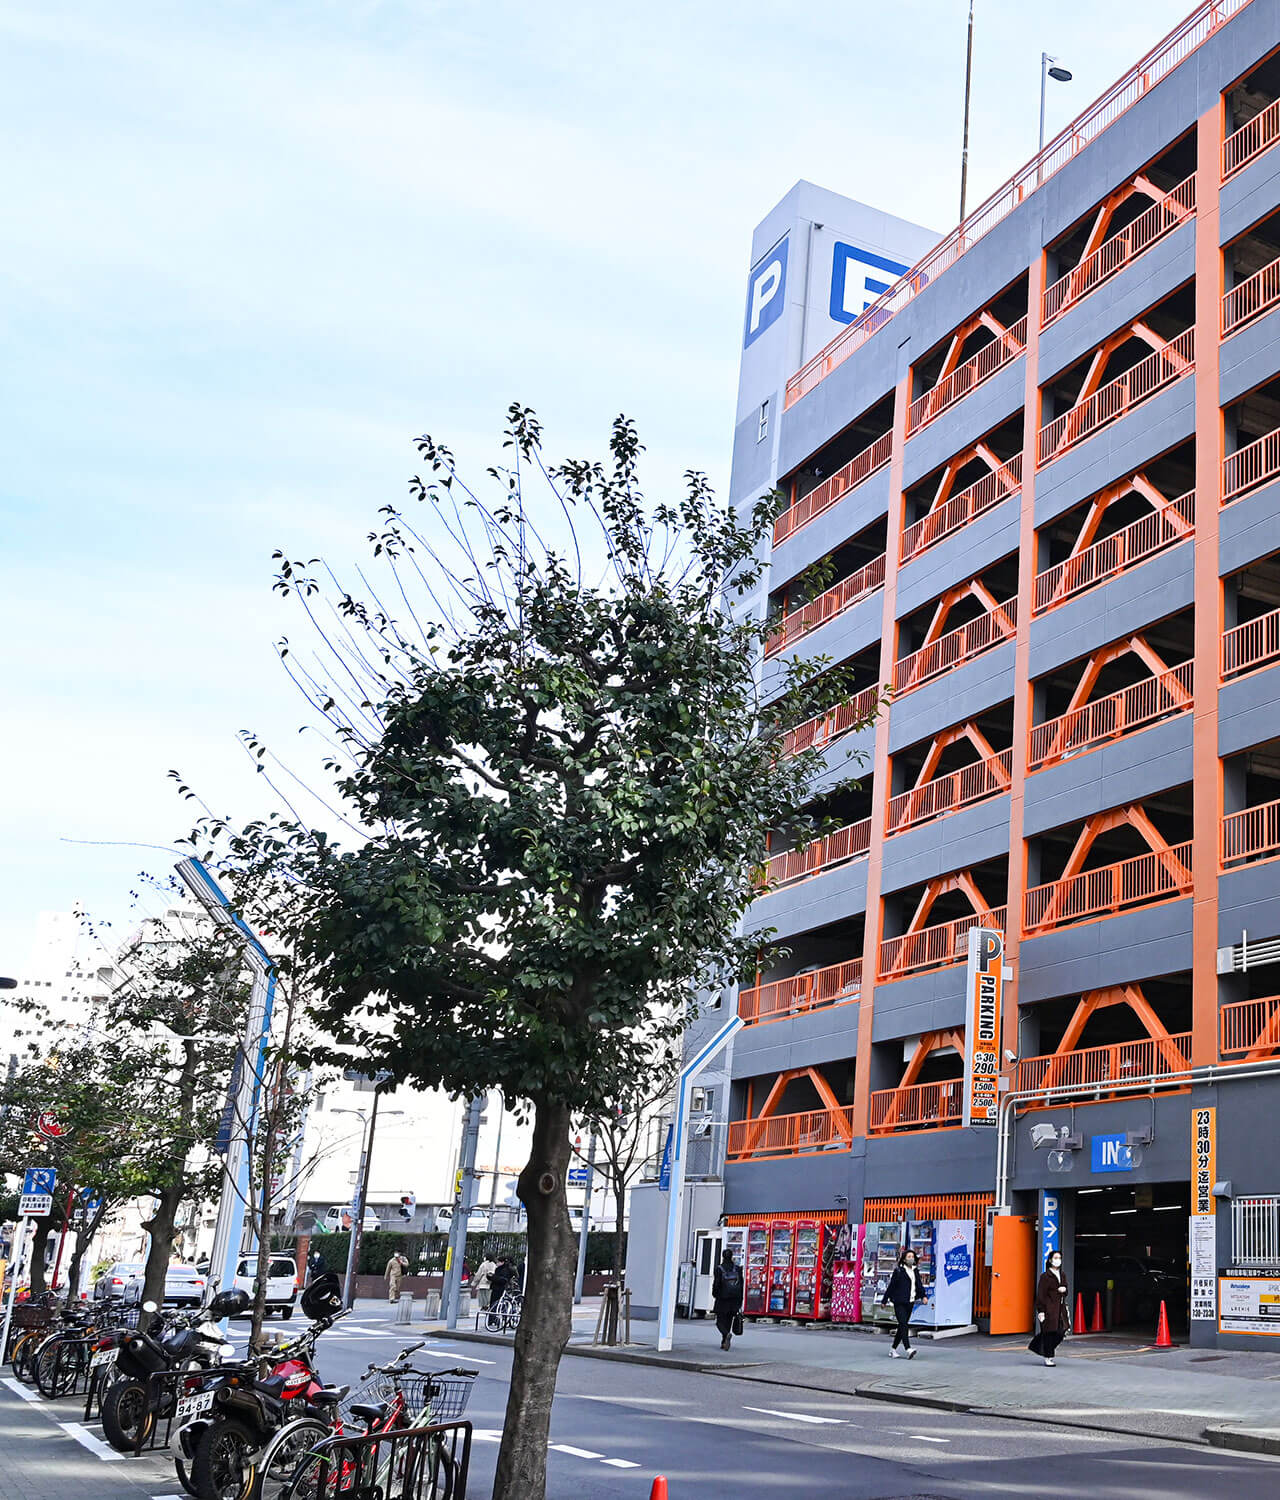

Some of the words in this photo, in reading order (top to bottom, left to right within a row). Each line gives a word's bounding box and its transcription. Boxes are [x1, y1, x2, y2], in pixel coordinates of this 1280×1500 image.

[749, 259, 782, 334] P
[981, 931, 1001, 972] P
[979, 975, 996, 1040] PARKING
[973, 1063, 998, 1075] 290
[974, 1083, 996, 1092] 1,500
[973, 1098, 996, 1107] 2,500
[1102, 1140, 1120, 1166] IN
[1196, 1110, 1211, 1213] 23時30分迄営業
[31, 1171, 50, 1192] P
[1044, 1197, 1058, 1217] P
[178, 1399, 209, 1416] 94-87
